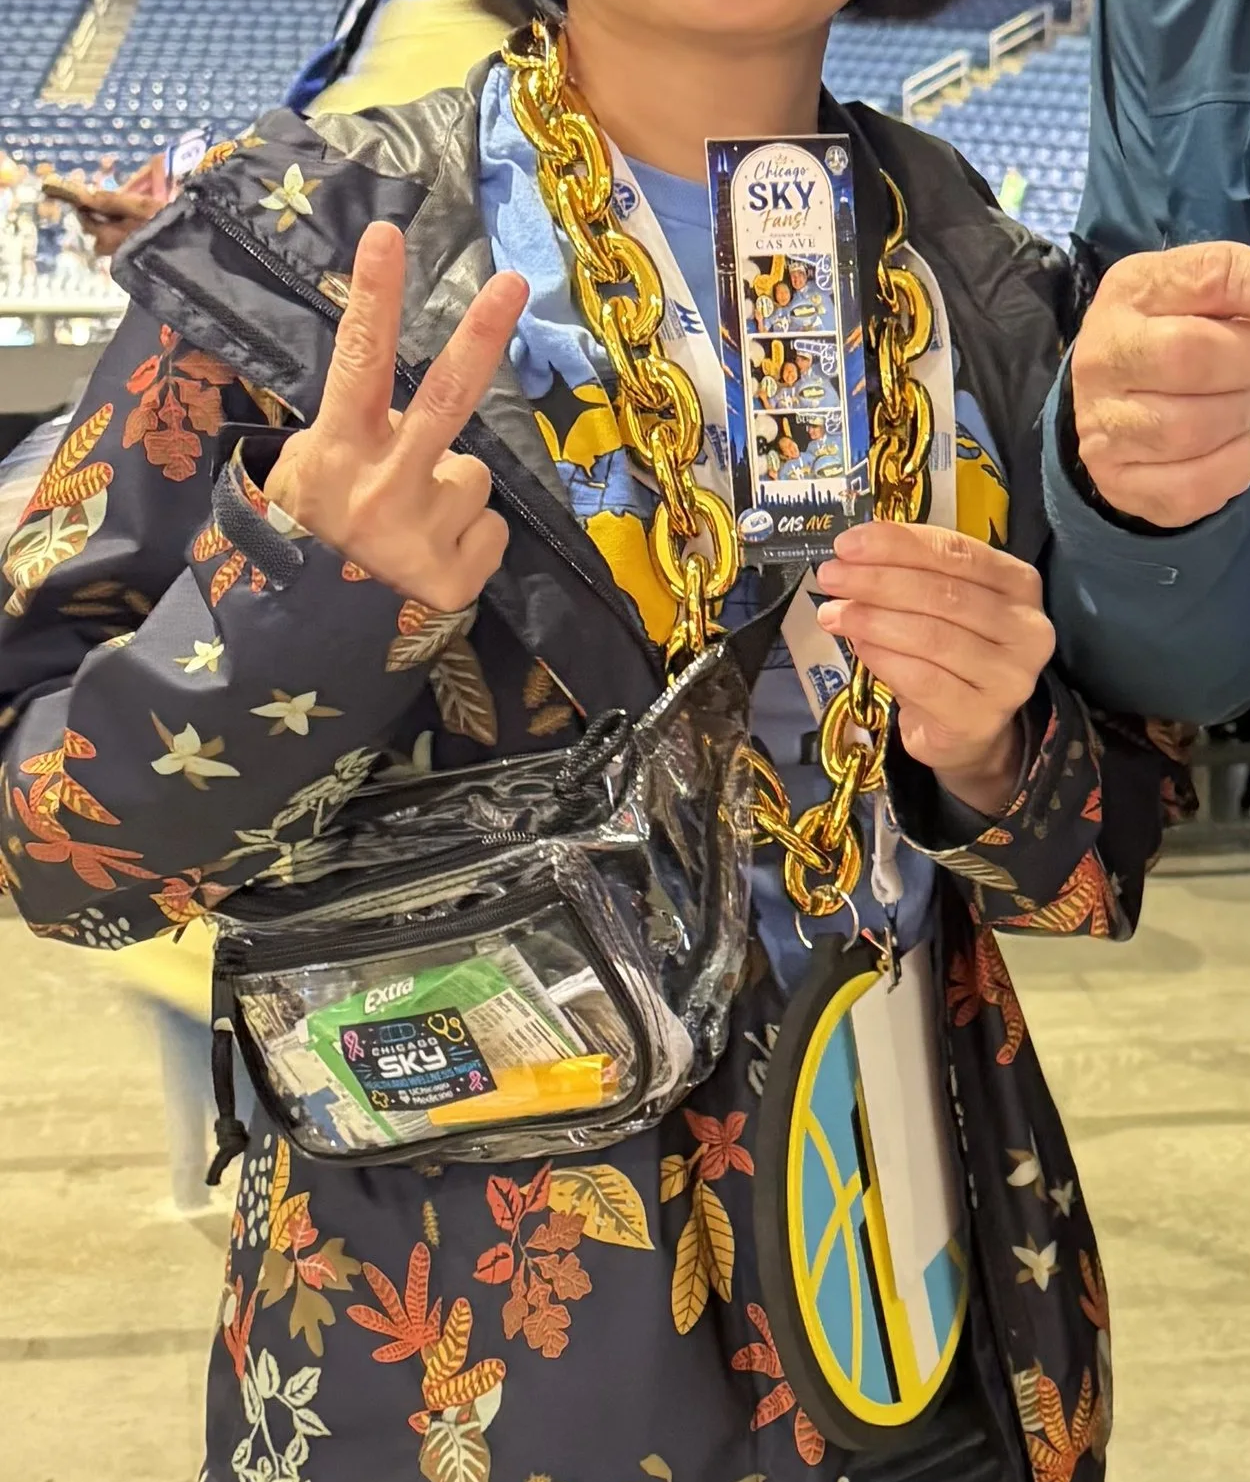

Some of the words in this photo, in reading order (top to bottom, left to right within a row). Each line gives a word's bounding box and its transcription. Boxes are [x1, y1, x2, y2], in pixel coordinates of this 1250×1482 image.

[753, 161, 809, 184] Chicago
[748, 181, 815, 211] SKY
[760, 206, 810, 233] Fans!
[756, 240, 782, 250] CAS
[790, 239, 816, 249] AVE
[777, 515, 804, 533] CAS
[806, 513, 834, 531] AVE
[364, 976, 415, 1014] Extra
[372, 1037, 438, 1057] CHICAGO
[377, 1046, 448, 1079] SKY
